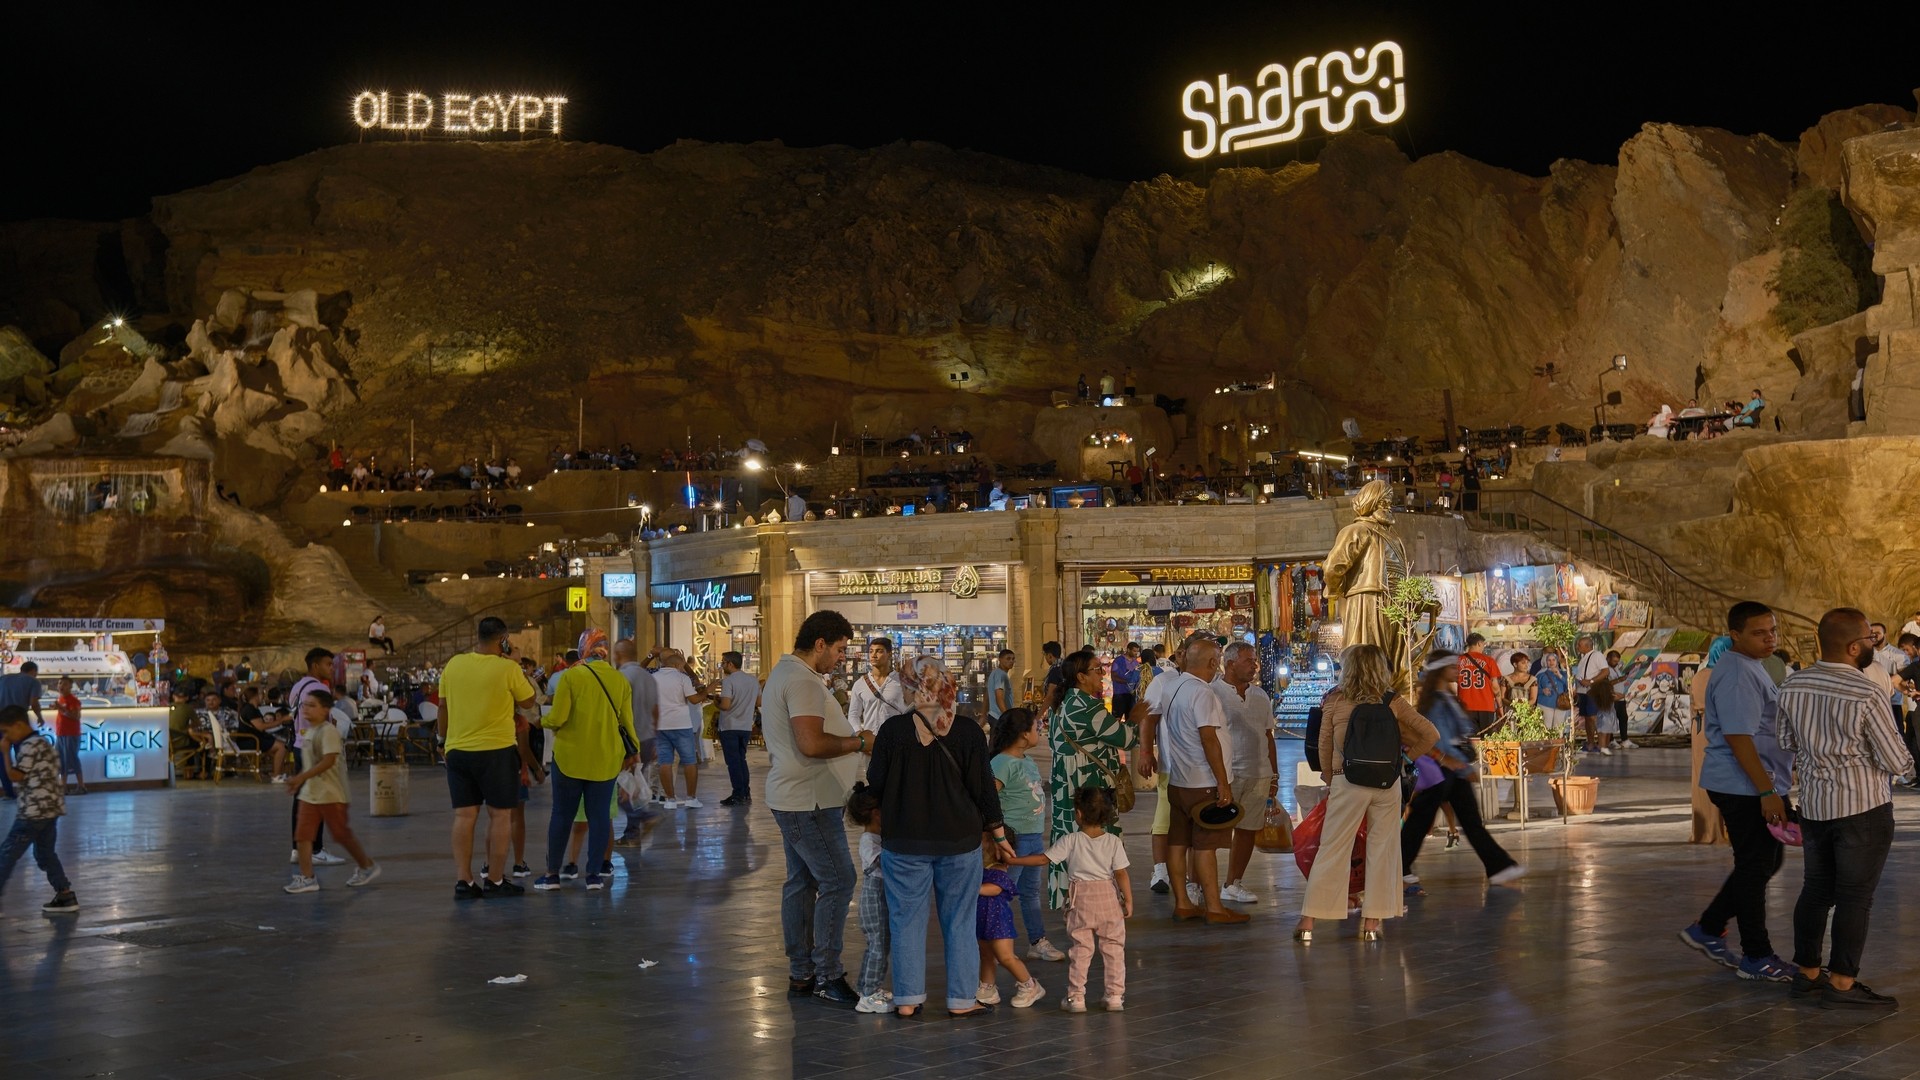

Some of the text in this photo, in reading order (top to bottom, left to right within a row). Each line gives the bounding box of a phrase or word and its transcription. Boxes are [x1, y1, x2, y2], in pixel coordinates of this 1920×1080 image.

[354, 91, 569, 134] OLD EGYPT
[675, 581, 727, 611] Abu Auf
[36, 618, 134, 630] Mövenpick Ice Cream
[1460, 668, 1486, 689] 33
